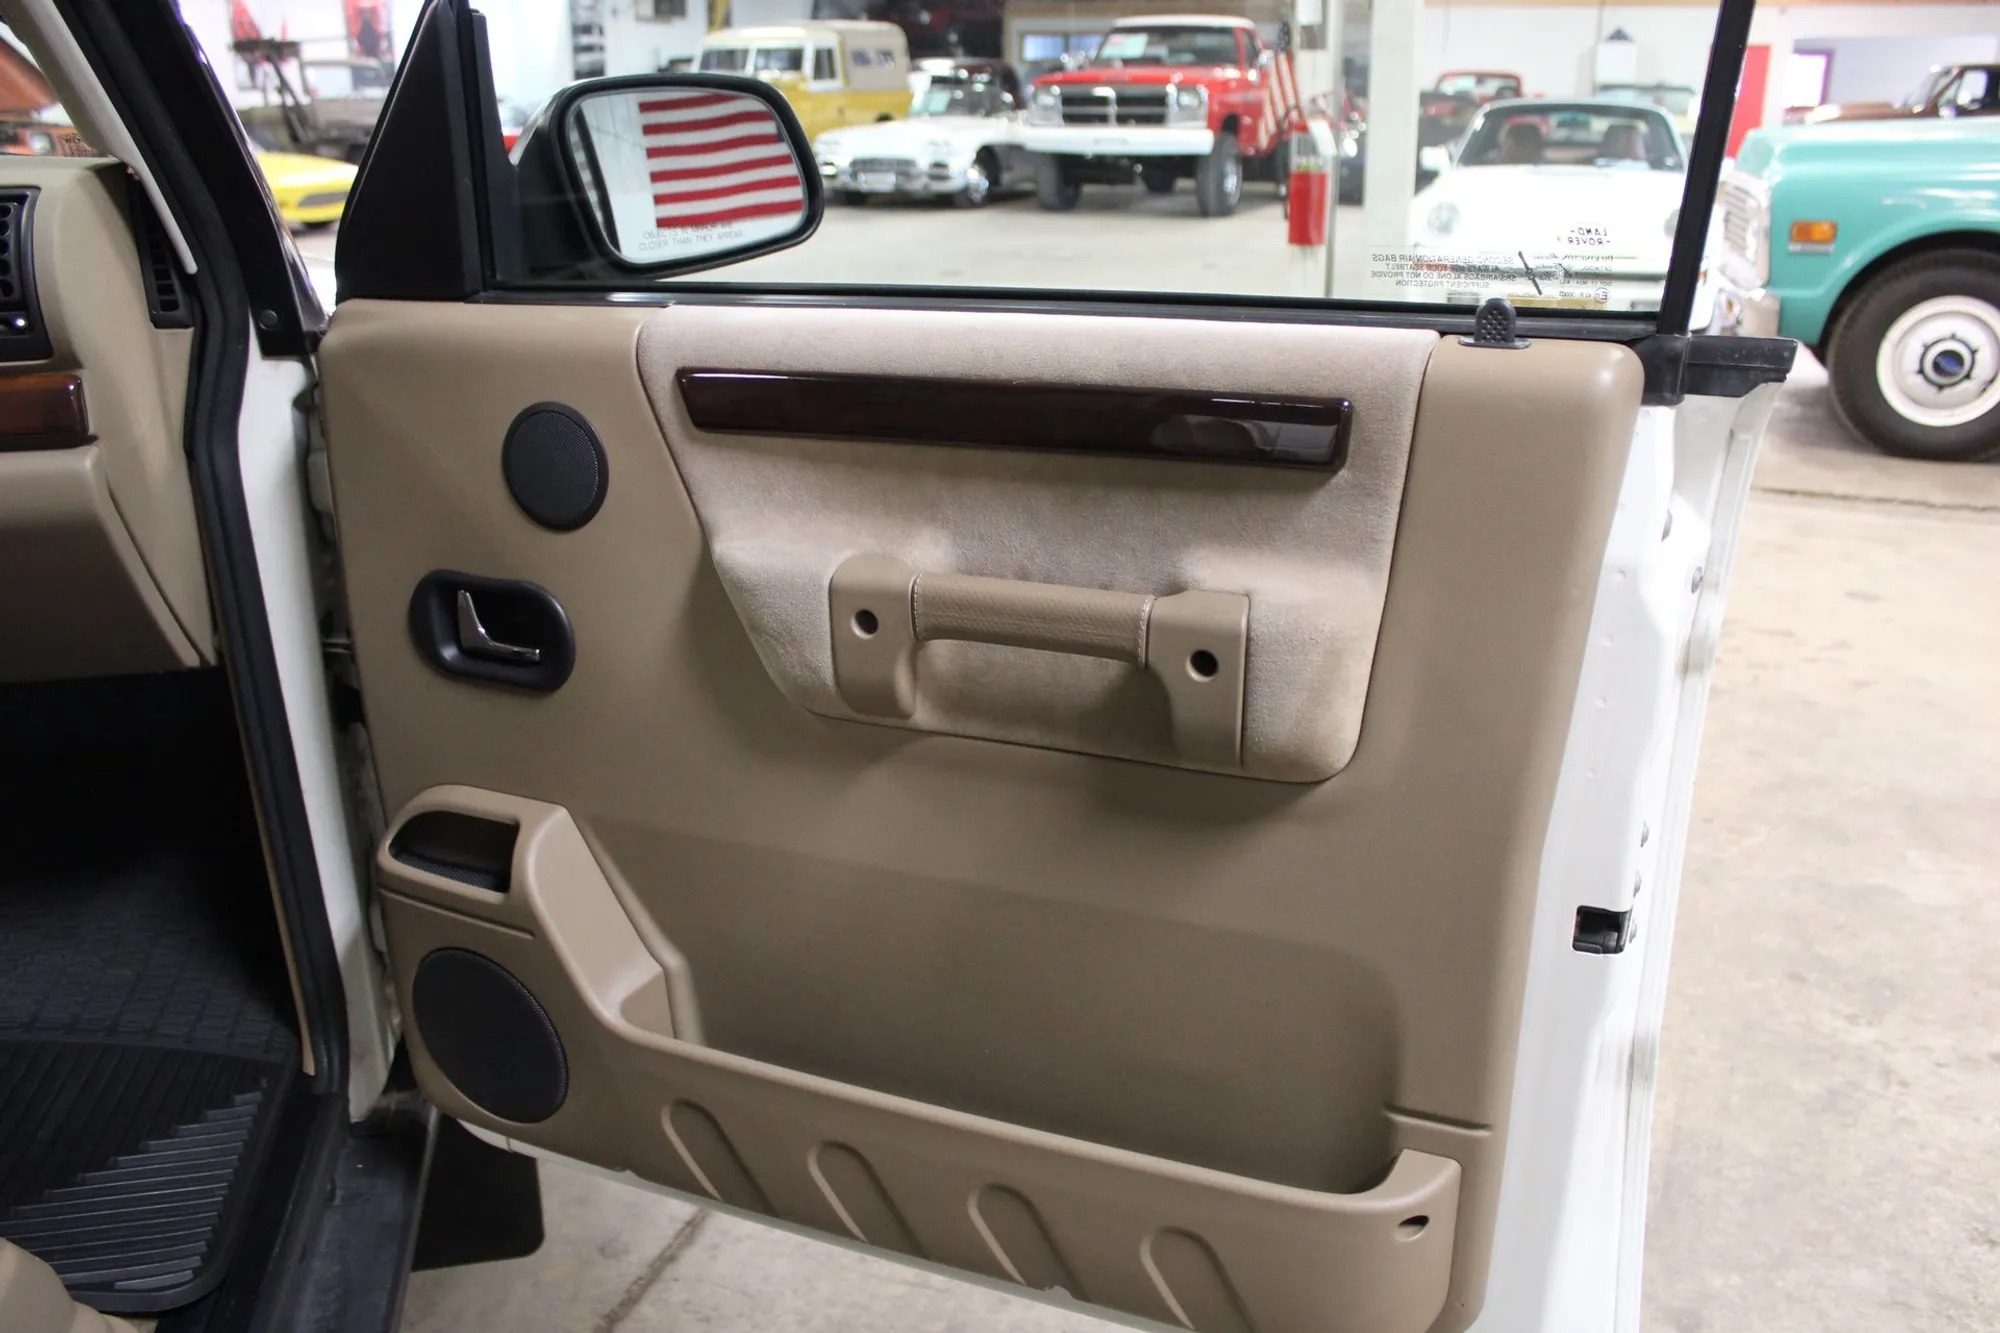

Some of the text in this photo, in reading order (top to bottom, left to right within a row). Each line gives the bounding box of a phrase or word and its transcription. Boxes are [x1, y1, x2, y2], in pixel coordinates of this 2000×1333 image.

[638, 229, 744, 252] CLOSER THAN THEY APPEAR
